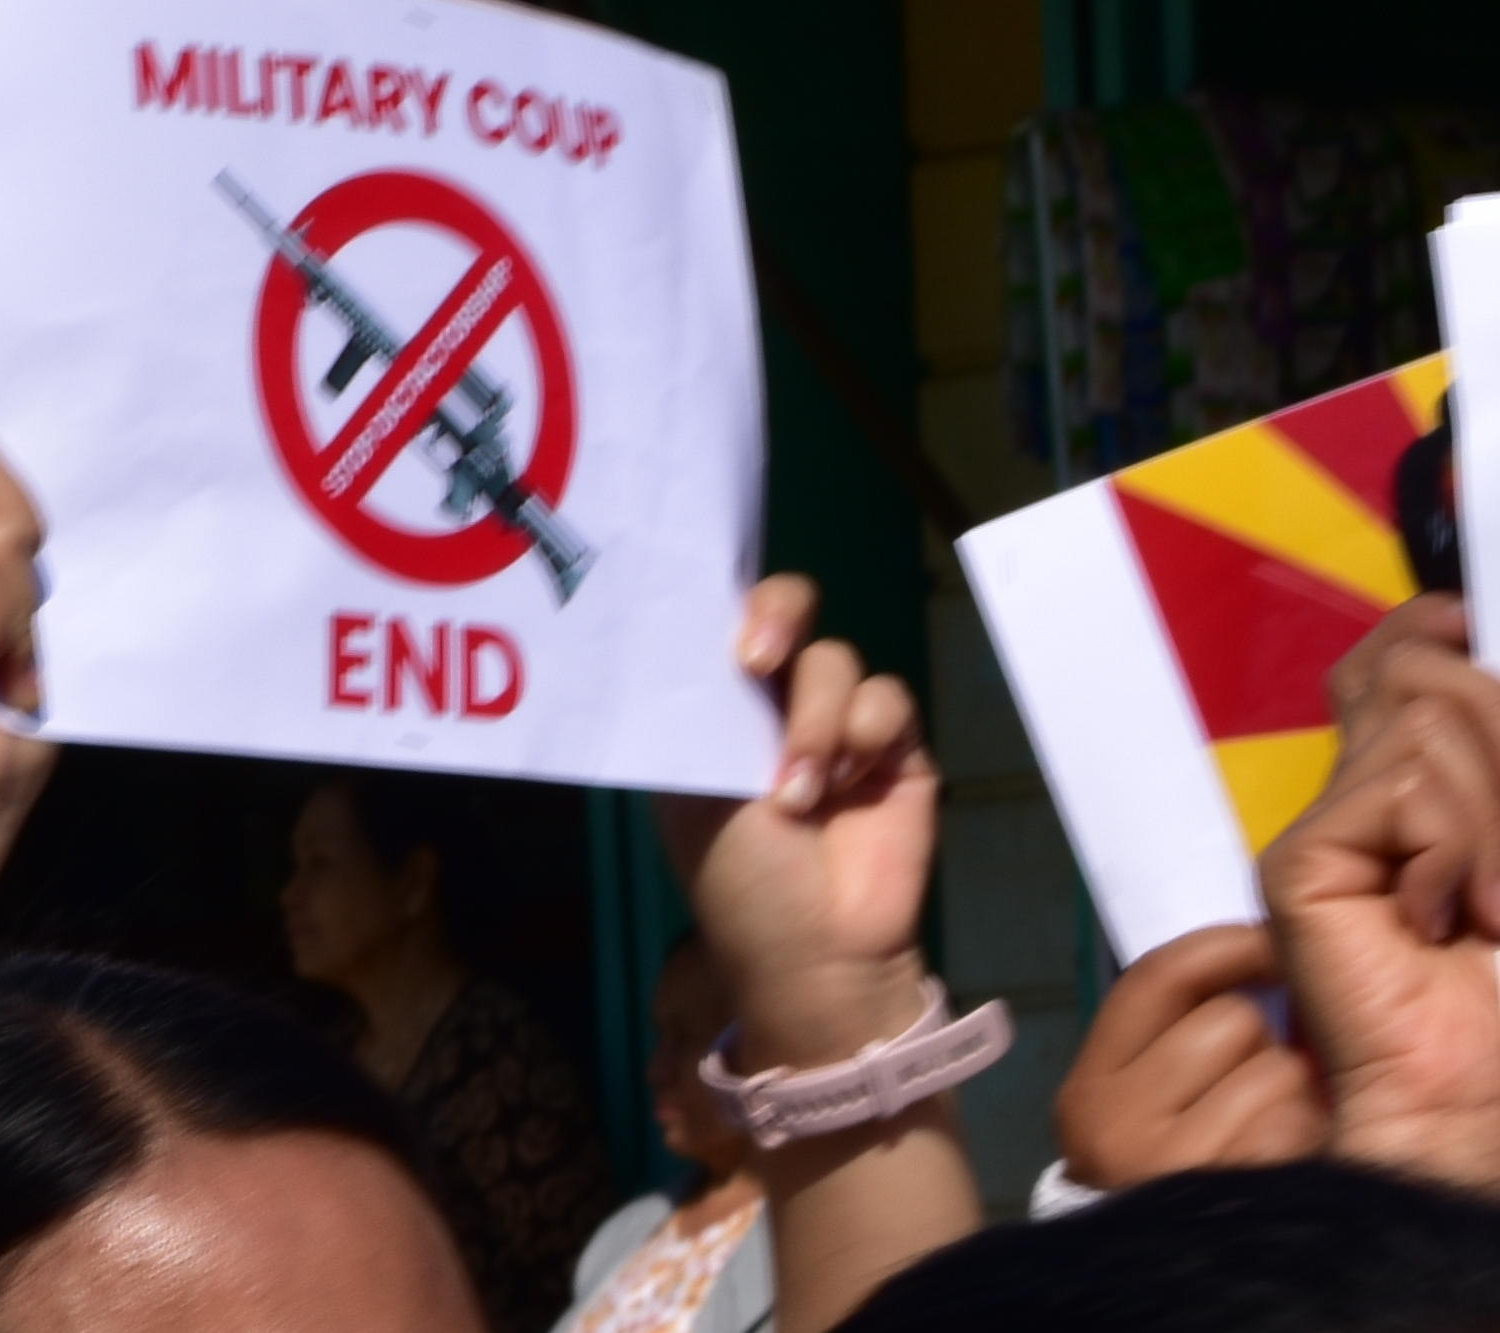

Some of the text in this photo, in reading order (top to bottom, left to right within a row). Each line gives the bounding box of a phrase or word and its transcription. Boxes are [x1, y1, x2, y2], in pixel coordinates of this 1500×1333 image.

[133, 41, 624, 170] MILITARY COUP
[327, 609, 526, 721] END
